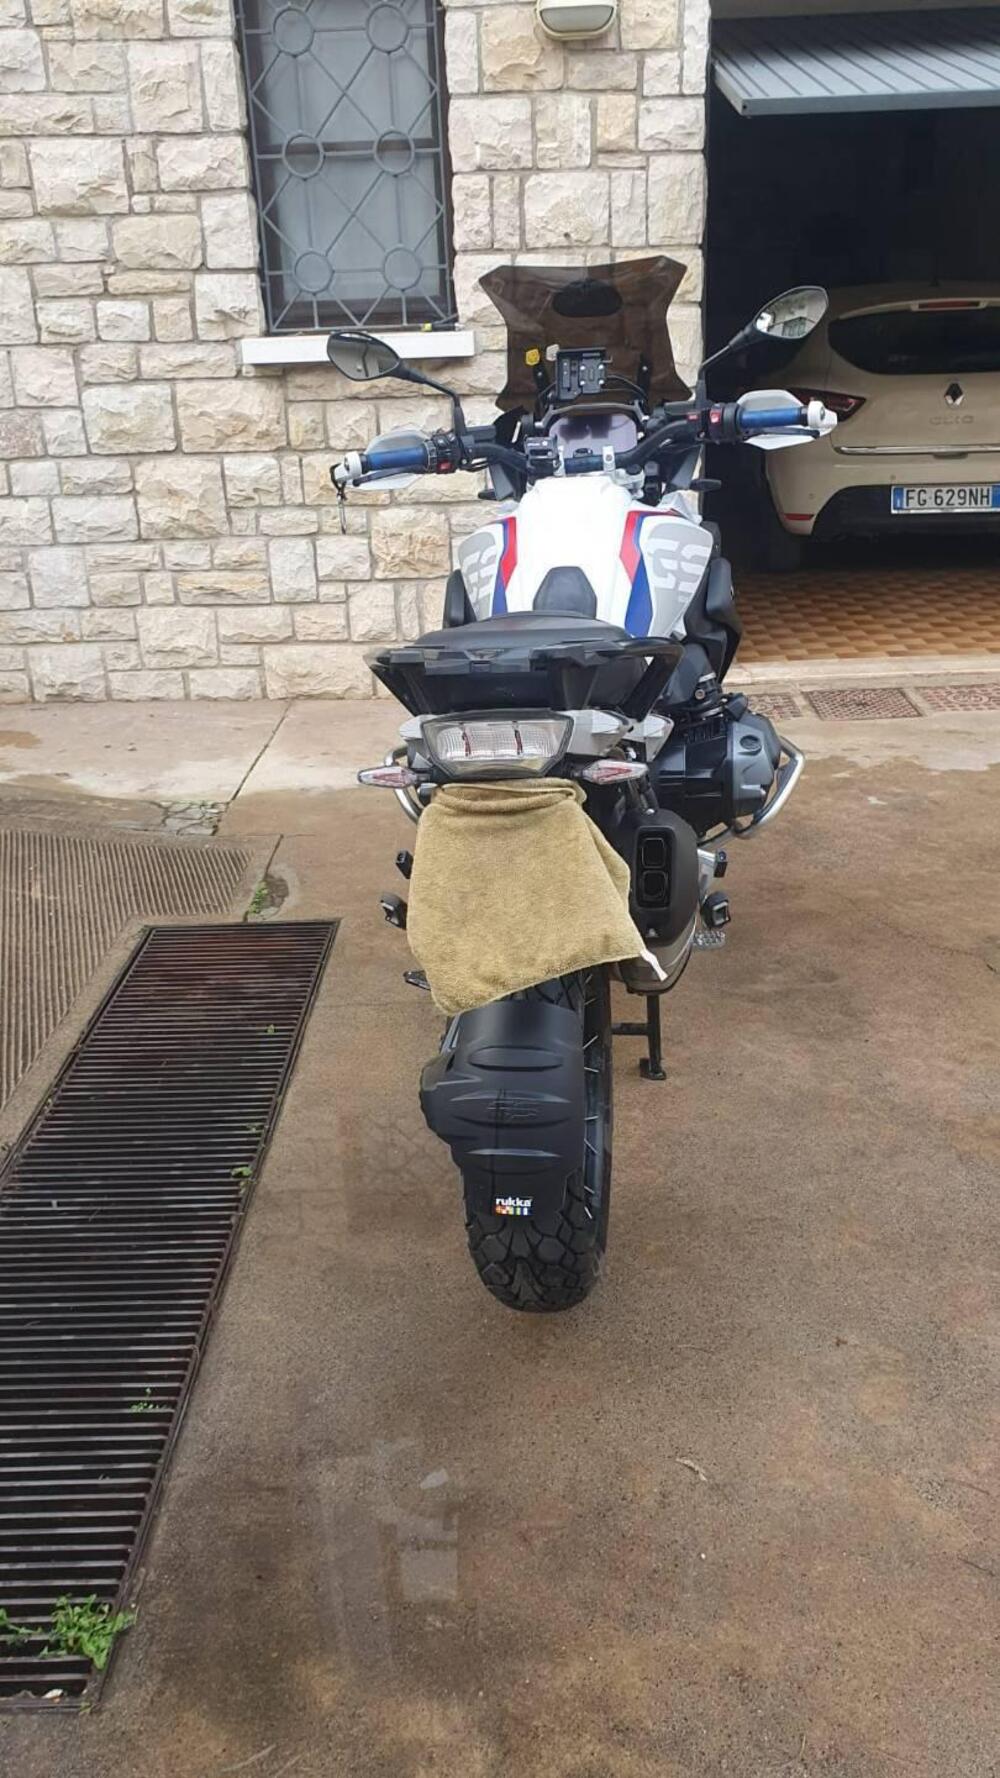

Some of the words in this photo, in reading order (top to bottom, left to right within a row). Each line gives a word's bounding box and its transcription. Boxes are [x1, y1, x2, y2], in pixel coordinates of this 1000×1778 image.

[905, 488, 928, 507] FG
[933, 486, 991, 507] 629NH
[495, 1196, 532, 1207] rukka
